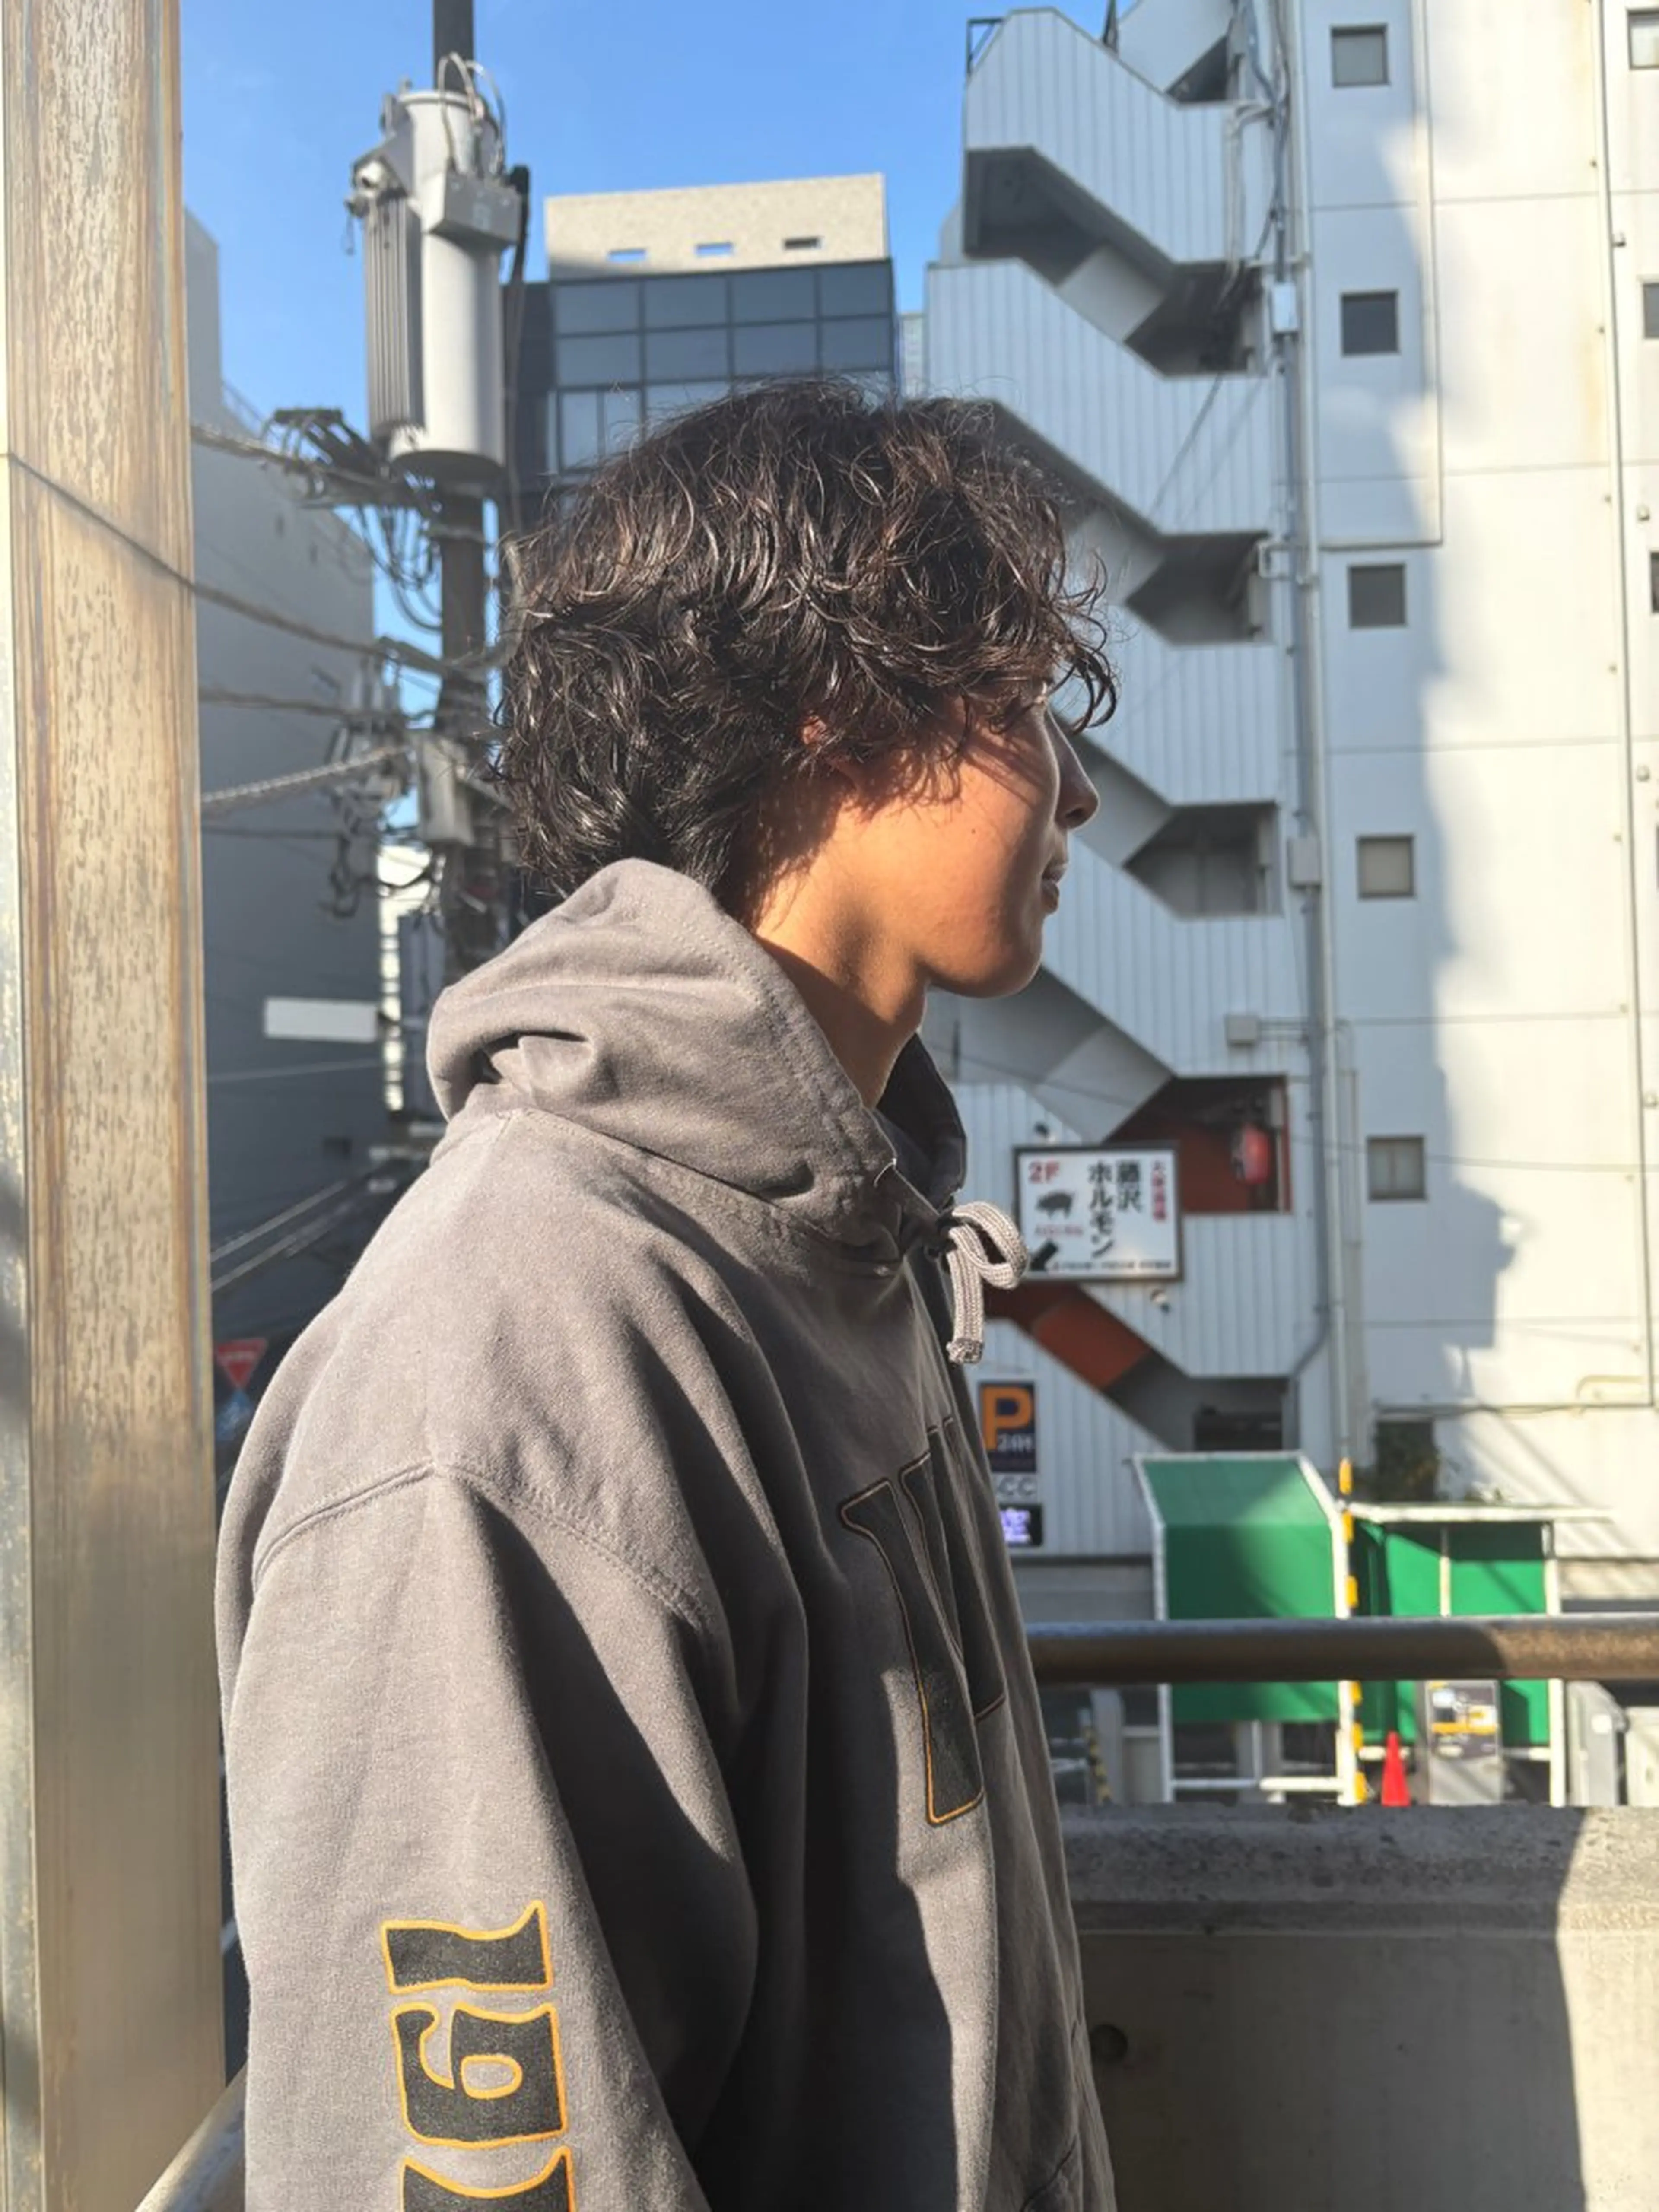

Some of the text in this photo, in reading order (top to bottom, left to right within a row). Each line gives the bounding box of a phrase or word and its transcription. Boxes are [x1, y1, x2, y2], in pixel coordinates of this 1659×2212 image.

[1028, 1160, 1060, 1184] 2F
[1087, 1160, 1116, 1259] ホルモン
[981, 1386, 1033, 1451] P
